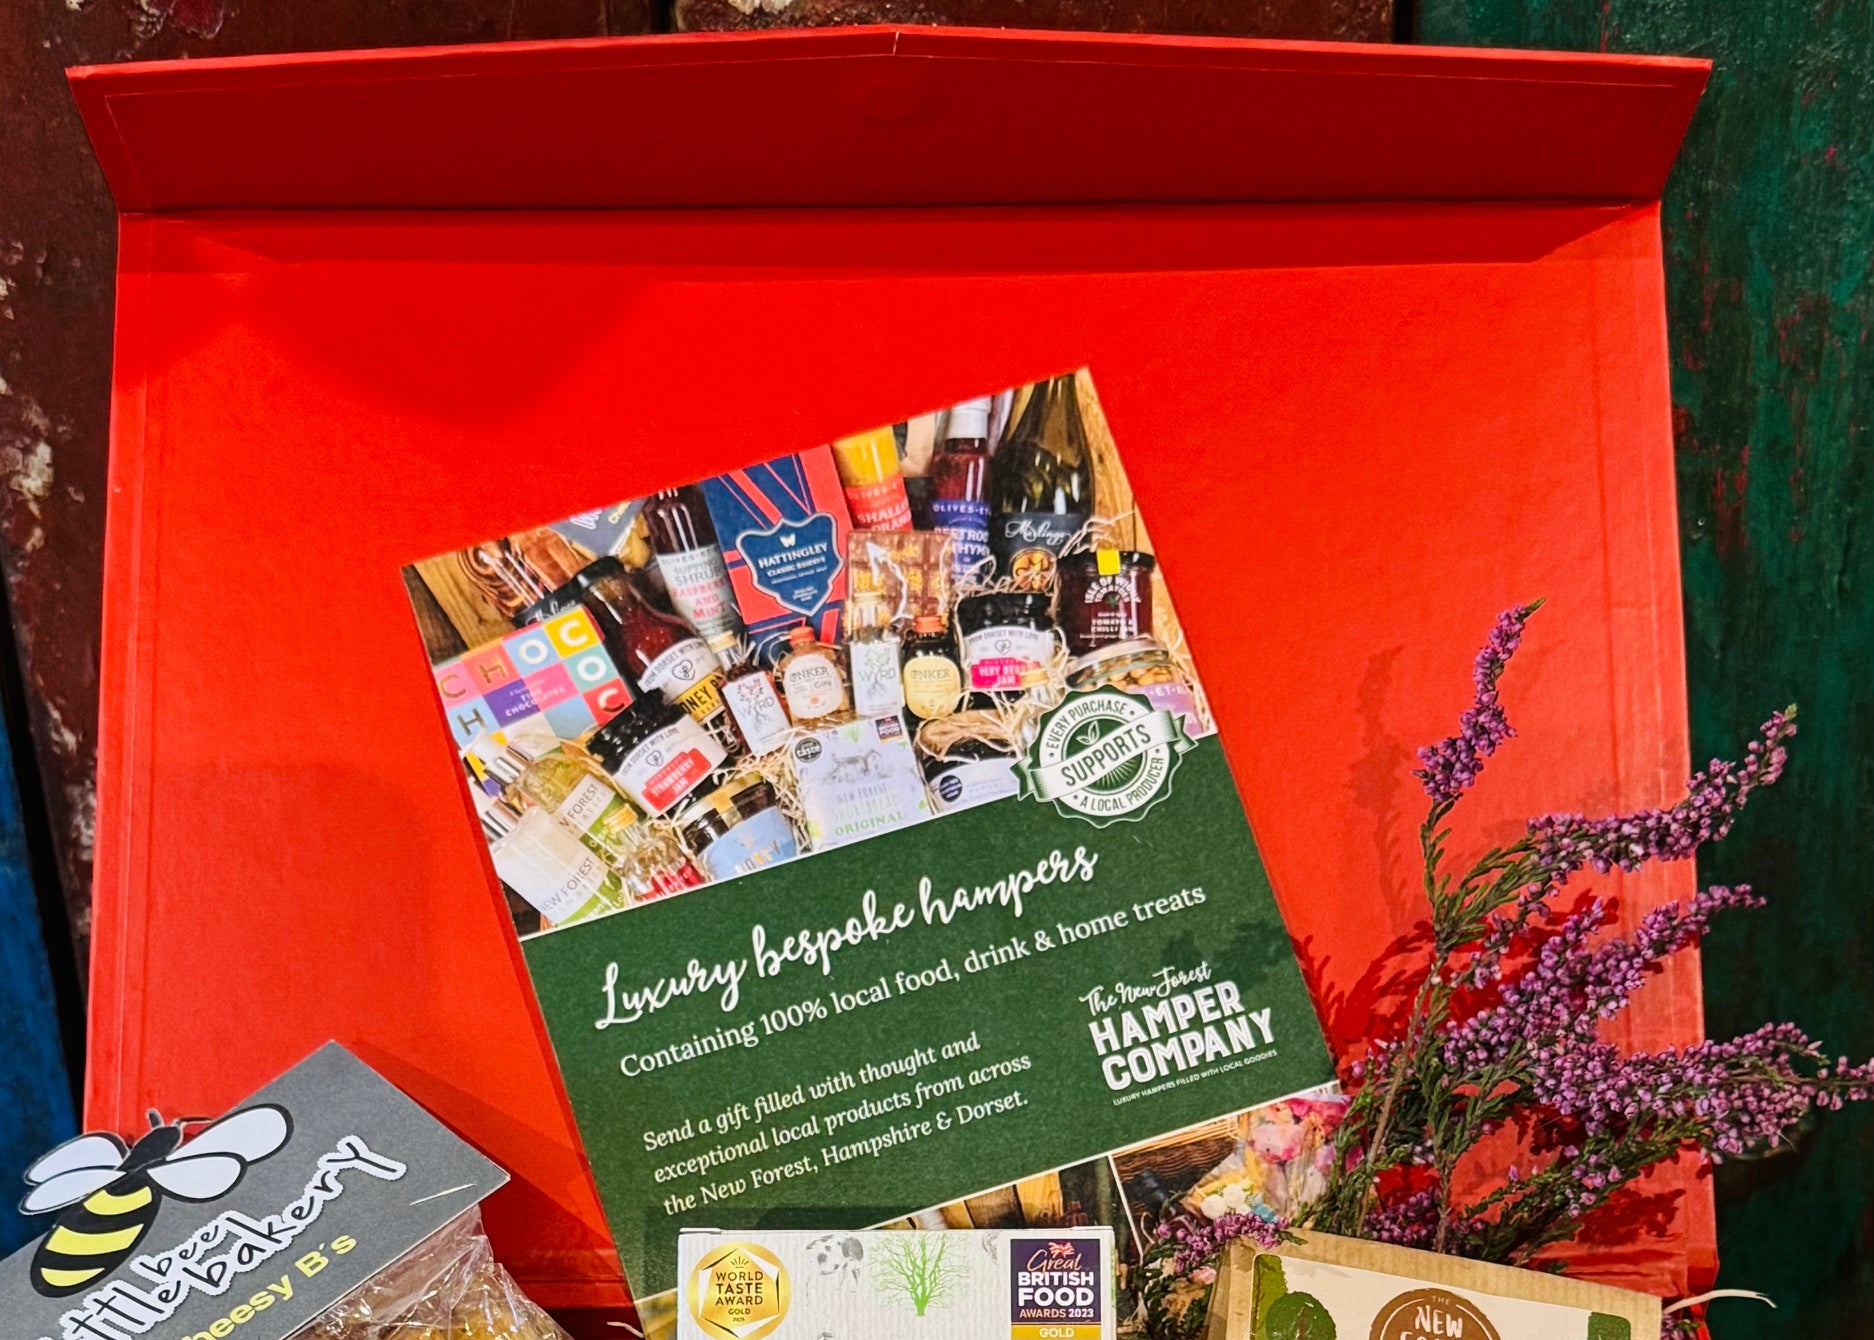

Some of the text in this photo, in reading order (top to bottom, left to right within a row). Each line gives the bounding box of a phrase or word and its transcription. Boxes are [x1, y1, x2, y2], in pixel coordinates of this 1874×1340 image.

[758, 542, 828, 569] HATTINGLEY
[1051, 699, 1129, 751] EVERY PURCHASE
[1061, 723, 1152, 788] SUPPORTS
[567, 783, 598, 820] FOREST
[1080, 755, 1165, 812] A LOCAL PRODUCER
[835, 812, 905, 837] ORIGINAL
[595, 845, 1100, 1031] Luxury bespoke hampers
[620, 885, 1206, 1078] Containing 100% local food, drink & home treats
[1078, 960, 1212, 1017] The New Forest
[1088, 979, 1246, 1057] HAMPER
[1101, 1007, 1275, 1092] COMPANY
[642, 1032, 981, 1153] Send a gift filled with thought and
[1112, 1049, 1278, 1106] LUXURY HAMPERS FILLED WITH LOCAL GOODIES
[653, 1053, 1033, 1184] exceptional local products from across
[662, 1087, 1030, 1217] the New Forest, Hampshire & Dorset.
[182, 1138, 404, 1291] bakery
[136, 1222, 222, 1276] bee
[715, 1270, 764, 1282] WORLD
[715, 1282, 764, 1295] TASTE
[715, 1295, 764, 1306] AWARD
[1018, 1271, 1095, 1286] BRITISH
[1018, 1286, 1095, 1307] FOOD
[1432, 1295, 1451, 1306] THE
[1020, 1307, 1095, 1318] AWARDS 2023
[1039, 1327, 1075, 1338] GOLD
[1414, 1304, 1464, 1339] NEW
